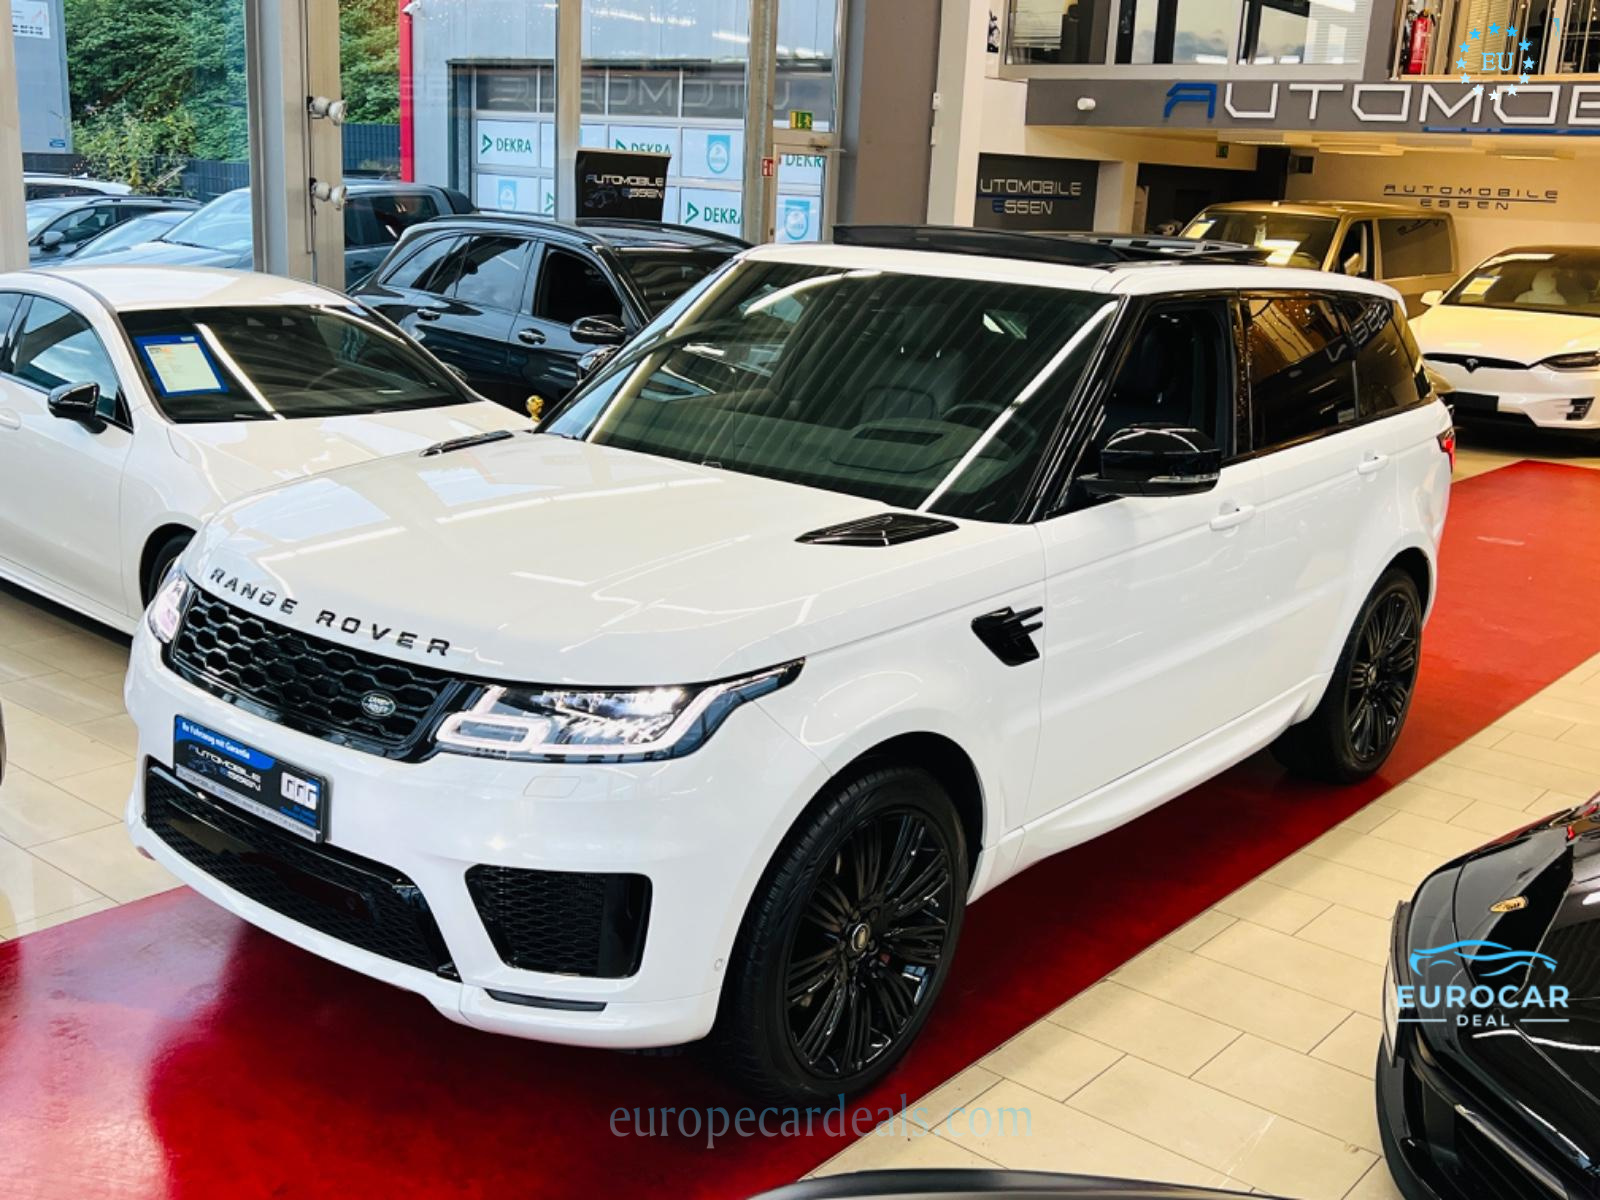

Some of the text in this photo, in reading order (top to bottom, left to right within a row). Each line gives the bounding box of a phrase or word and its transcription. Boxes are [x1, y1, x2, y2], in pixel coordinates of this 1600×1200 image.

[496, 138, 532, 153] DEKRA
[786, 155, 822, 168] DEKR
[585, 174, 664, 187] AUTOMOBILE
[980, 178, 1083, 196] UTOMOBILE
[1384, 184, 1558, 199] AUTOMOBILE
[992, 198, 1053, 215] ESSEN
[1420, 198, 1509, 210] ESSEN
[210, 567, 451, 656] RANGE ROVER
[187, 744, 261, 784] AUTOMOBILE
